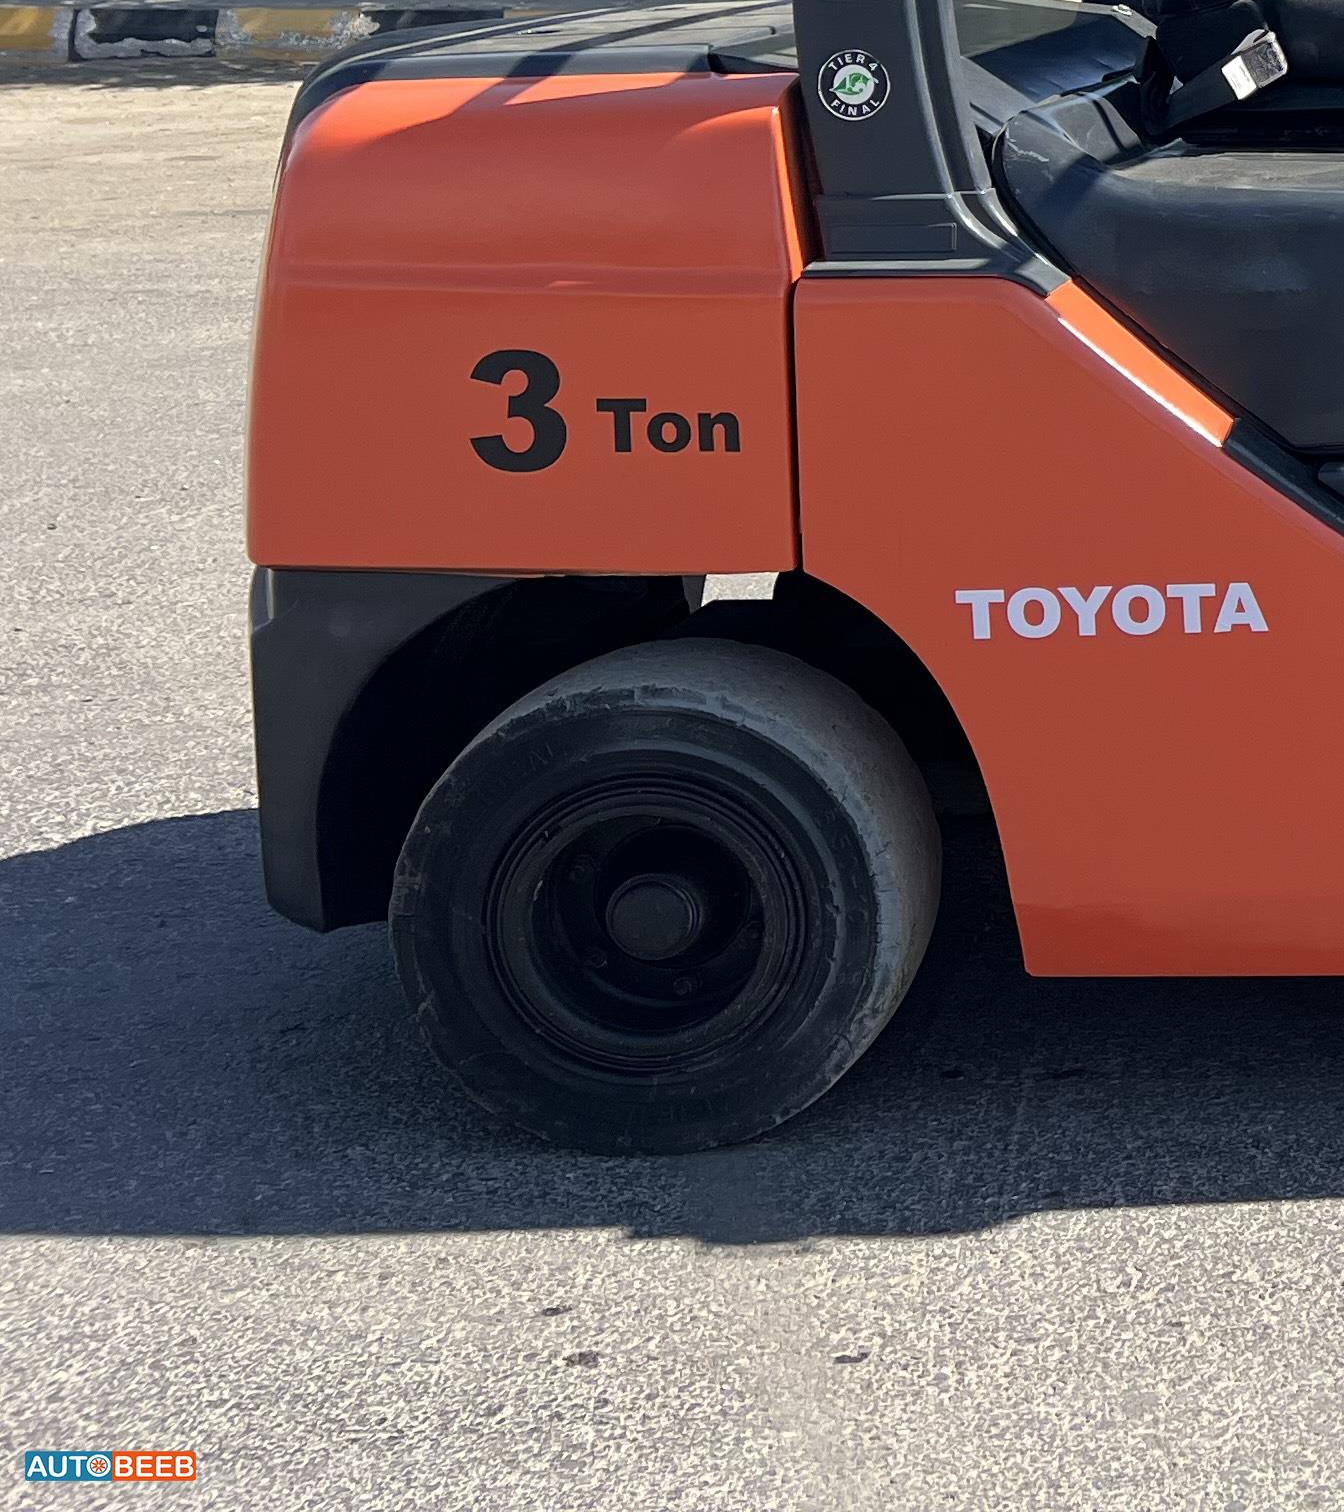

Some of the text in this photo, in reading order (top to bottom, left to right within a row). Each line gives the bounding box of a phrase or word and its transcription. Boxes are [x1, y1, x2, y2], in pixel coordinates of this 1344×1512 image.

[828, 53, 879, 71] TIER 4
[830, 99, 880, 116] FINAL
[469, 349, 742, 473] 3 Ton
[955, 581, 1270, 640] TOYOTA
